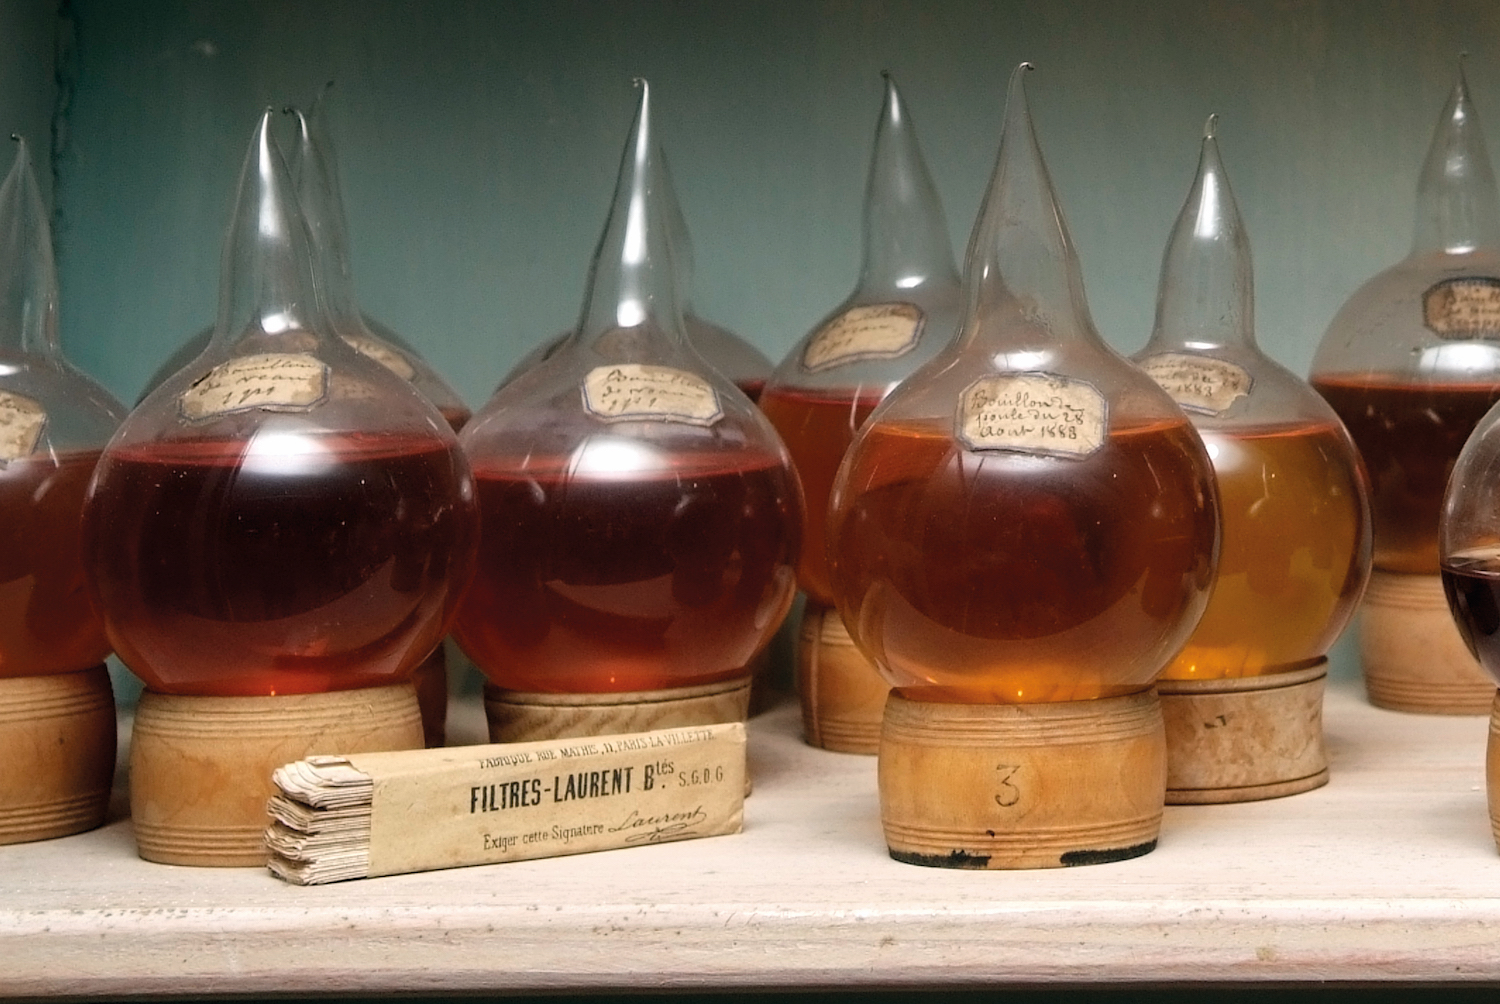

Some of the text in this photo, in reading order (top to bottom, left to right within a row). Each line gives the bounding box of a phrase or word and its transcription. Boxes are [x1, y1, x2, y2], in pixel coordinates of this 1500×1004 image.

[971, 389, 1085, 412] Bouillon de
[1176, 384, 1213, 397] 1883
[976, 409, 1084, 428] poule du 28
[1041, 424, 1078, 440] 1883
[478, 751, 533, 770] FABRIQUE
[537, 749, 557, 762] RUE
[559, 743, 599, 758] MATHIS
[470, 766, 634, 814] FILTRES-LAURENT
[994, 764, 1021, 808] 3
[483, 805, 708, 853] Exiger cette Signature Laurent
